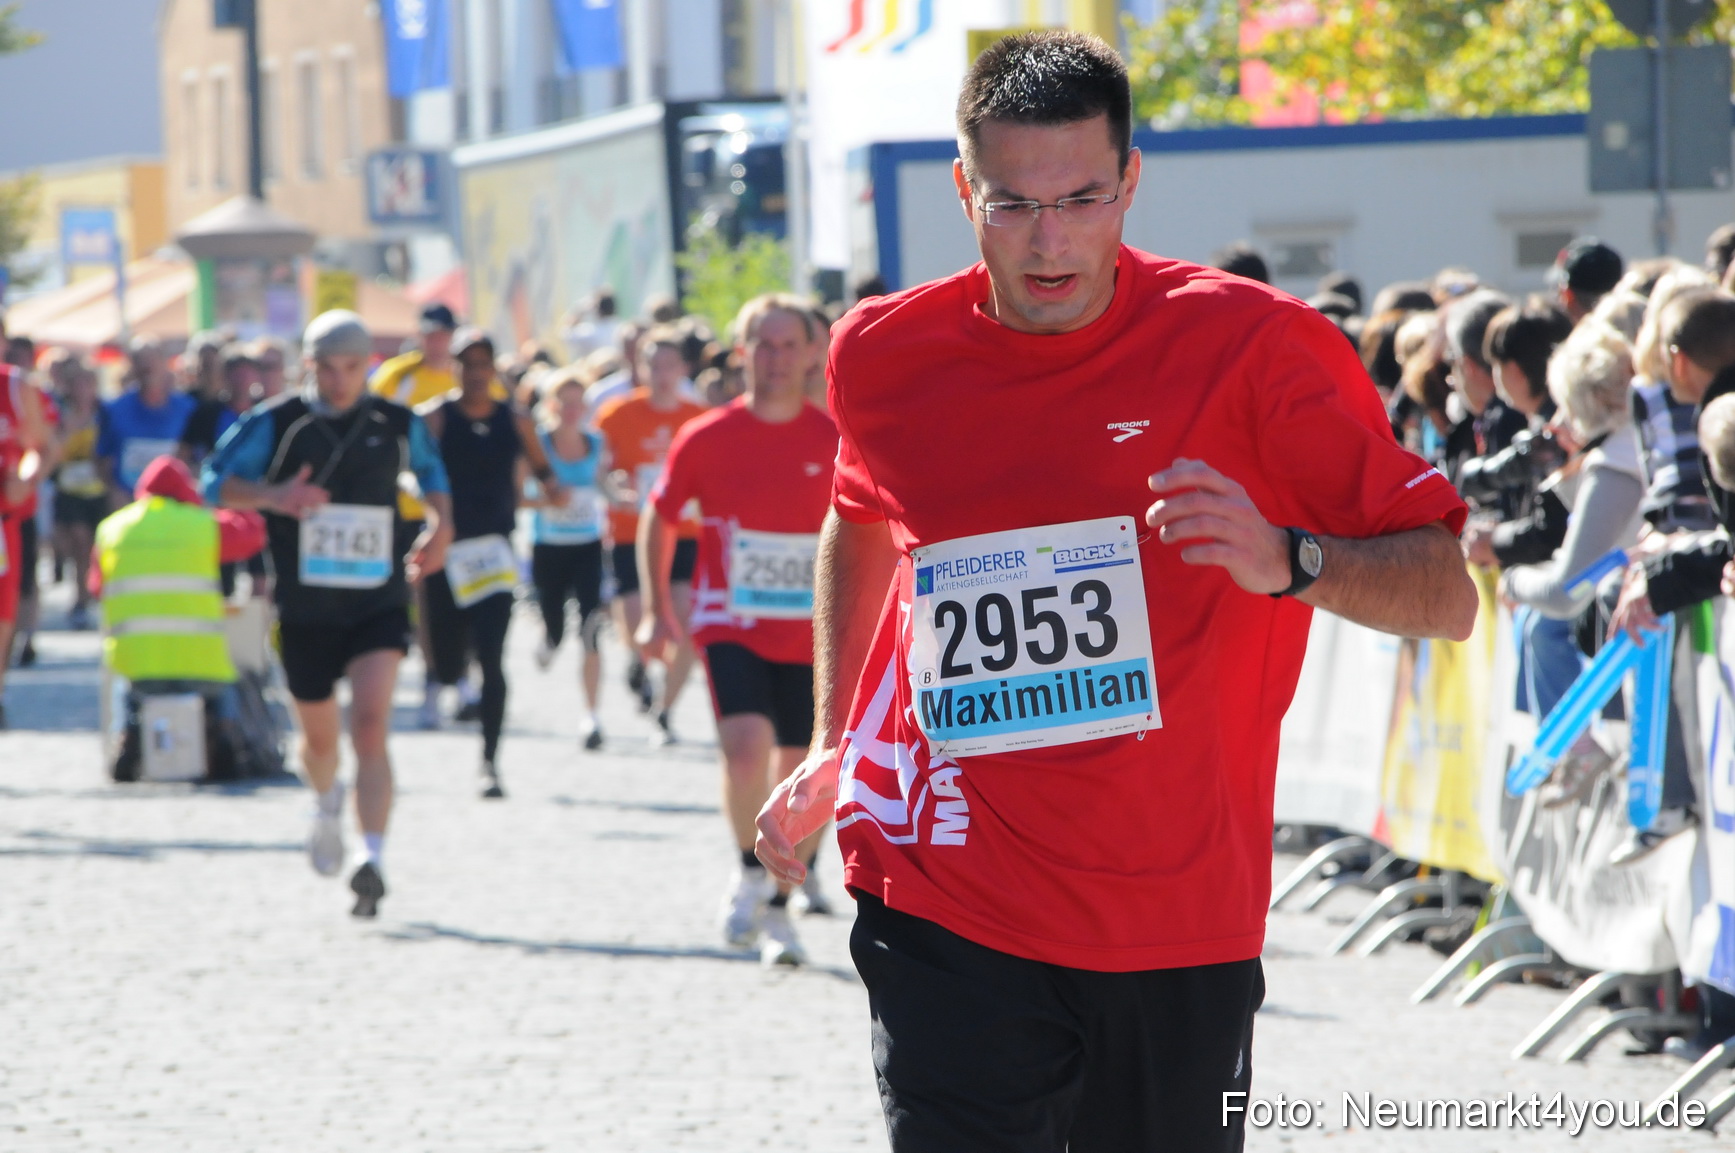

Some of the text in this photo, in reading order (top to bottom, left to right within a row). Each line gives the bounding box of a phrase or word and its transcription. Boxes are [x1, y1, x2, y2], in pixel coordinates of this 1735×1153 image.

[1106, 420, 1150, 429] BROOKS
[936, 550, 1027, 580] PFLEIDERER
[1053, 543, 1115, 565] BOCK
[936, 571, 1029, 592] AKTIENGESELLSCHAFT
[934, 579, 1119, 679] 2953
[921, 669, 1149, 730] Maximilian
